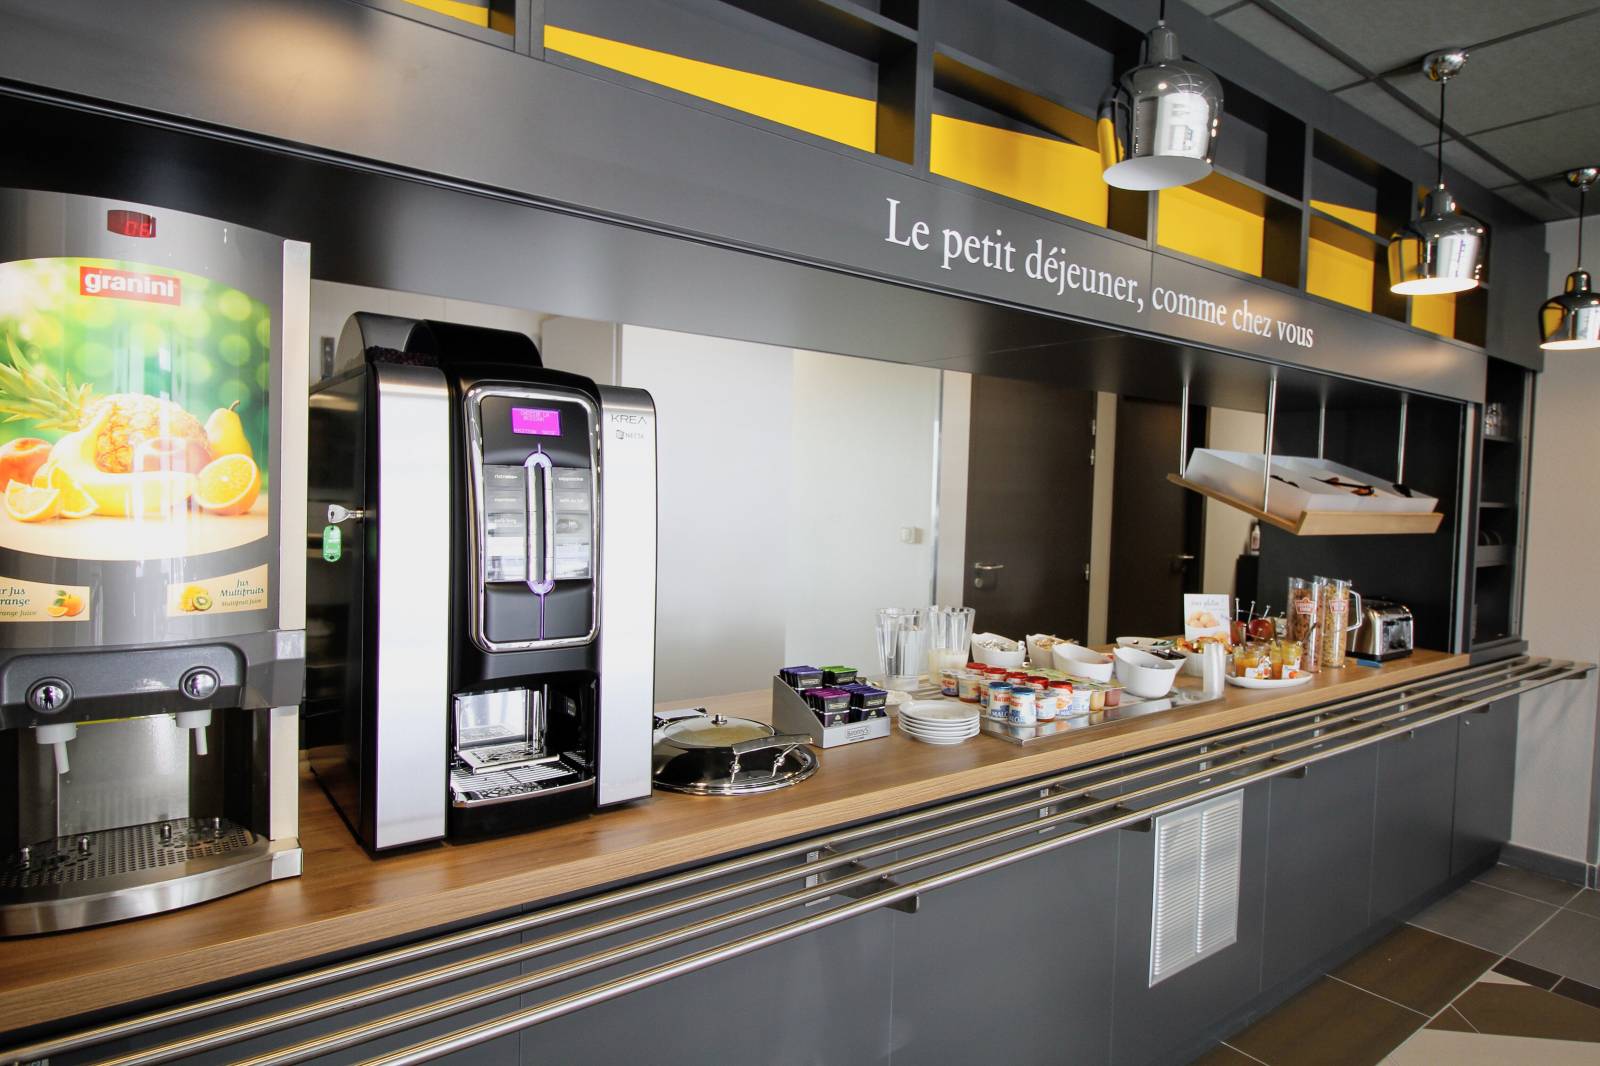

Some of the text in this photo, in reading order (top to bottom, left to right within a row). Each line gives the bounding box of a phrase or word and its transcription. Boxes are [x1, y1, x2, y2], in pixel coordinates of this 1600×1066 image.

[885, 198, 1313, 348] Le petit déjeuner, comme chez vous
[84, 272, 174, 297] granini
[611, 414, 648, 424] KREA
[9, 586, 26, 596] Jus
[220, 587, 265, 597] Multifruits
[0, 598, 31, 607] range
